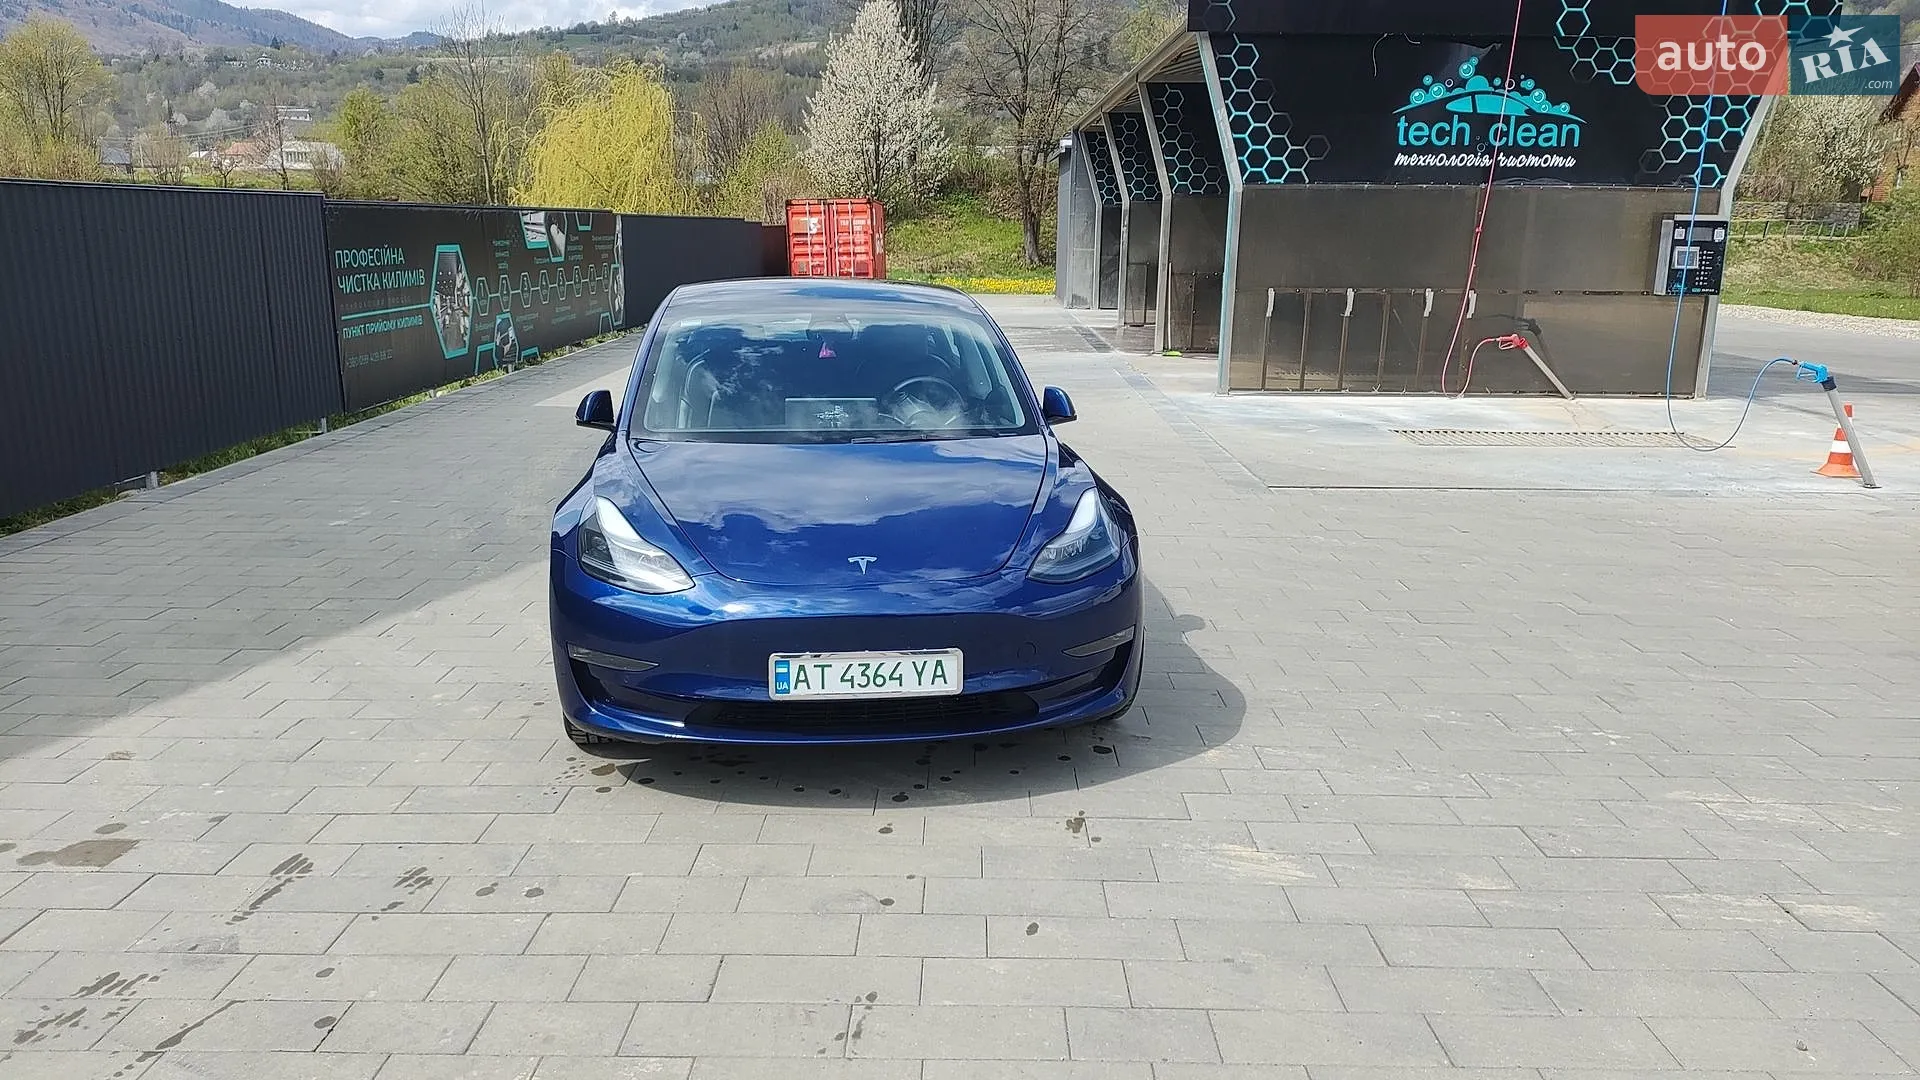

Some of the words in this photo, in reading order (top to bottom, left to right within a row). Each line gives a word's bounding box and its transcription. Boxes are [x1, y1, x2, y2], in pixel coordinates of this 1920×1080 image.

[1397, 114, 1471, 146] tech
[1489, 115, 1580, 147] clean
[1394, 151, 1492, 167] технологія
[1497, 151, 1577, 168] чистоти
[335, 243, 405, 268] ПРОФЕСІЙНА
[337, 272, 381, 294] ЧИСТКА
[381, 268, 426, 290] КИЛИМІВ
[776, 681, 789, 691] UA
[793, 663, 832, 690] AT
[840, 662, 903, 689] 4364
[911, 659, 948, 686] YA
